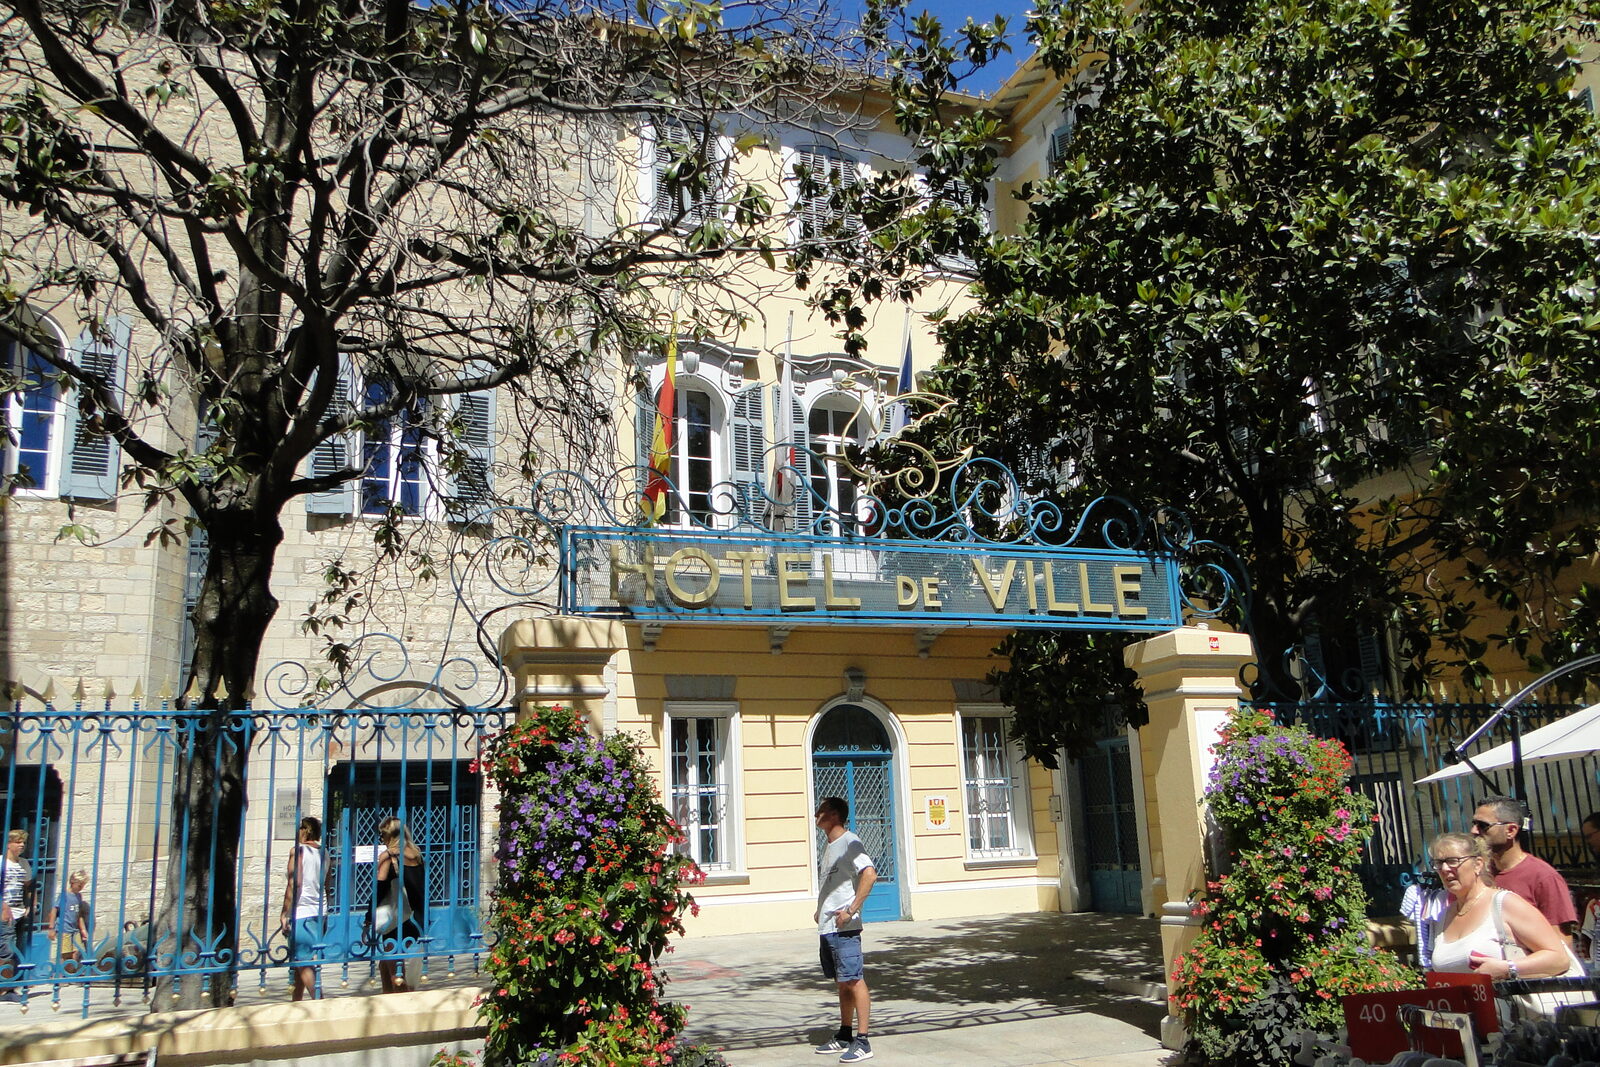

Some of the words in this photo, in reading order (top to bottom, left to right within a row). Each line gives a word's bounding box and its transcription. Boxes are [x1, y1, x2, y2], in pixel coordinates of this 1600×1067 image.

[609, 545, 861, 611] HOTEL
[896, 575, 942, 610] DE
[972, 559, 1148, 618] VILLE
[1471, 983, 1487, 1002] 38
[1359, 1003, 1386, 1024] 40
